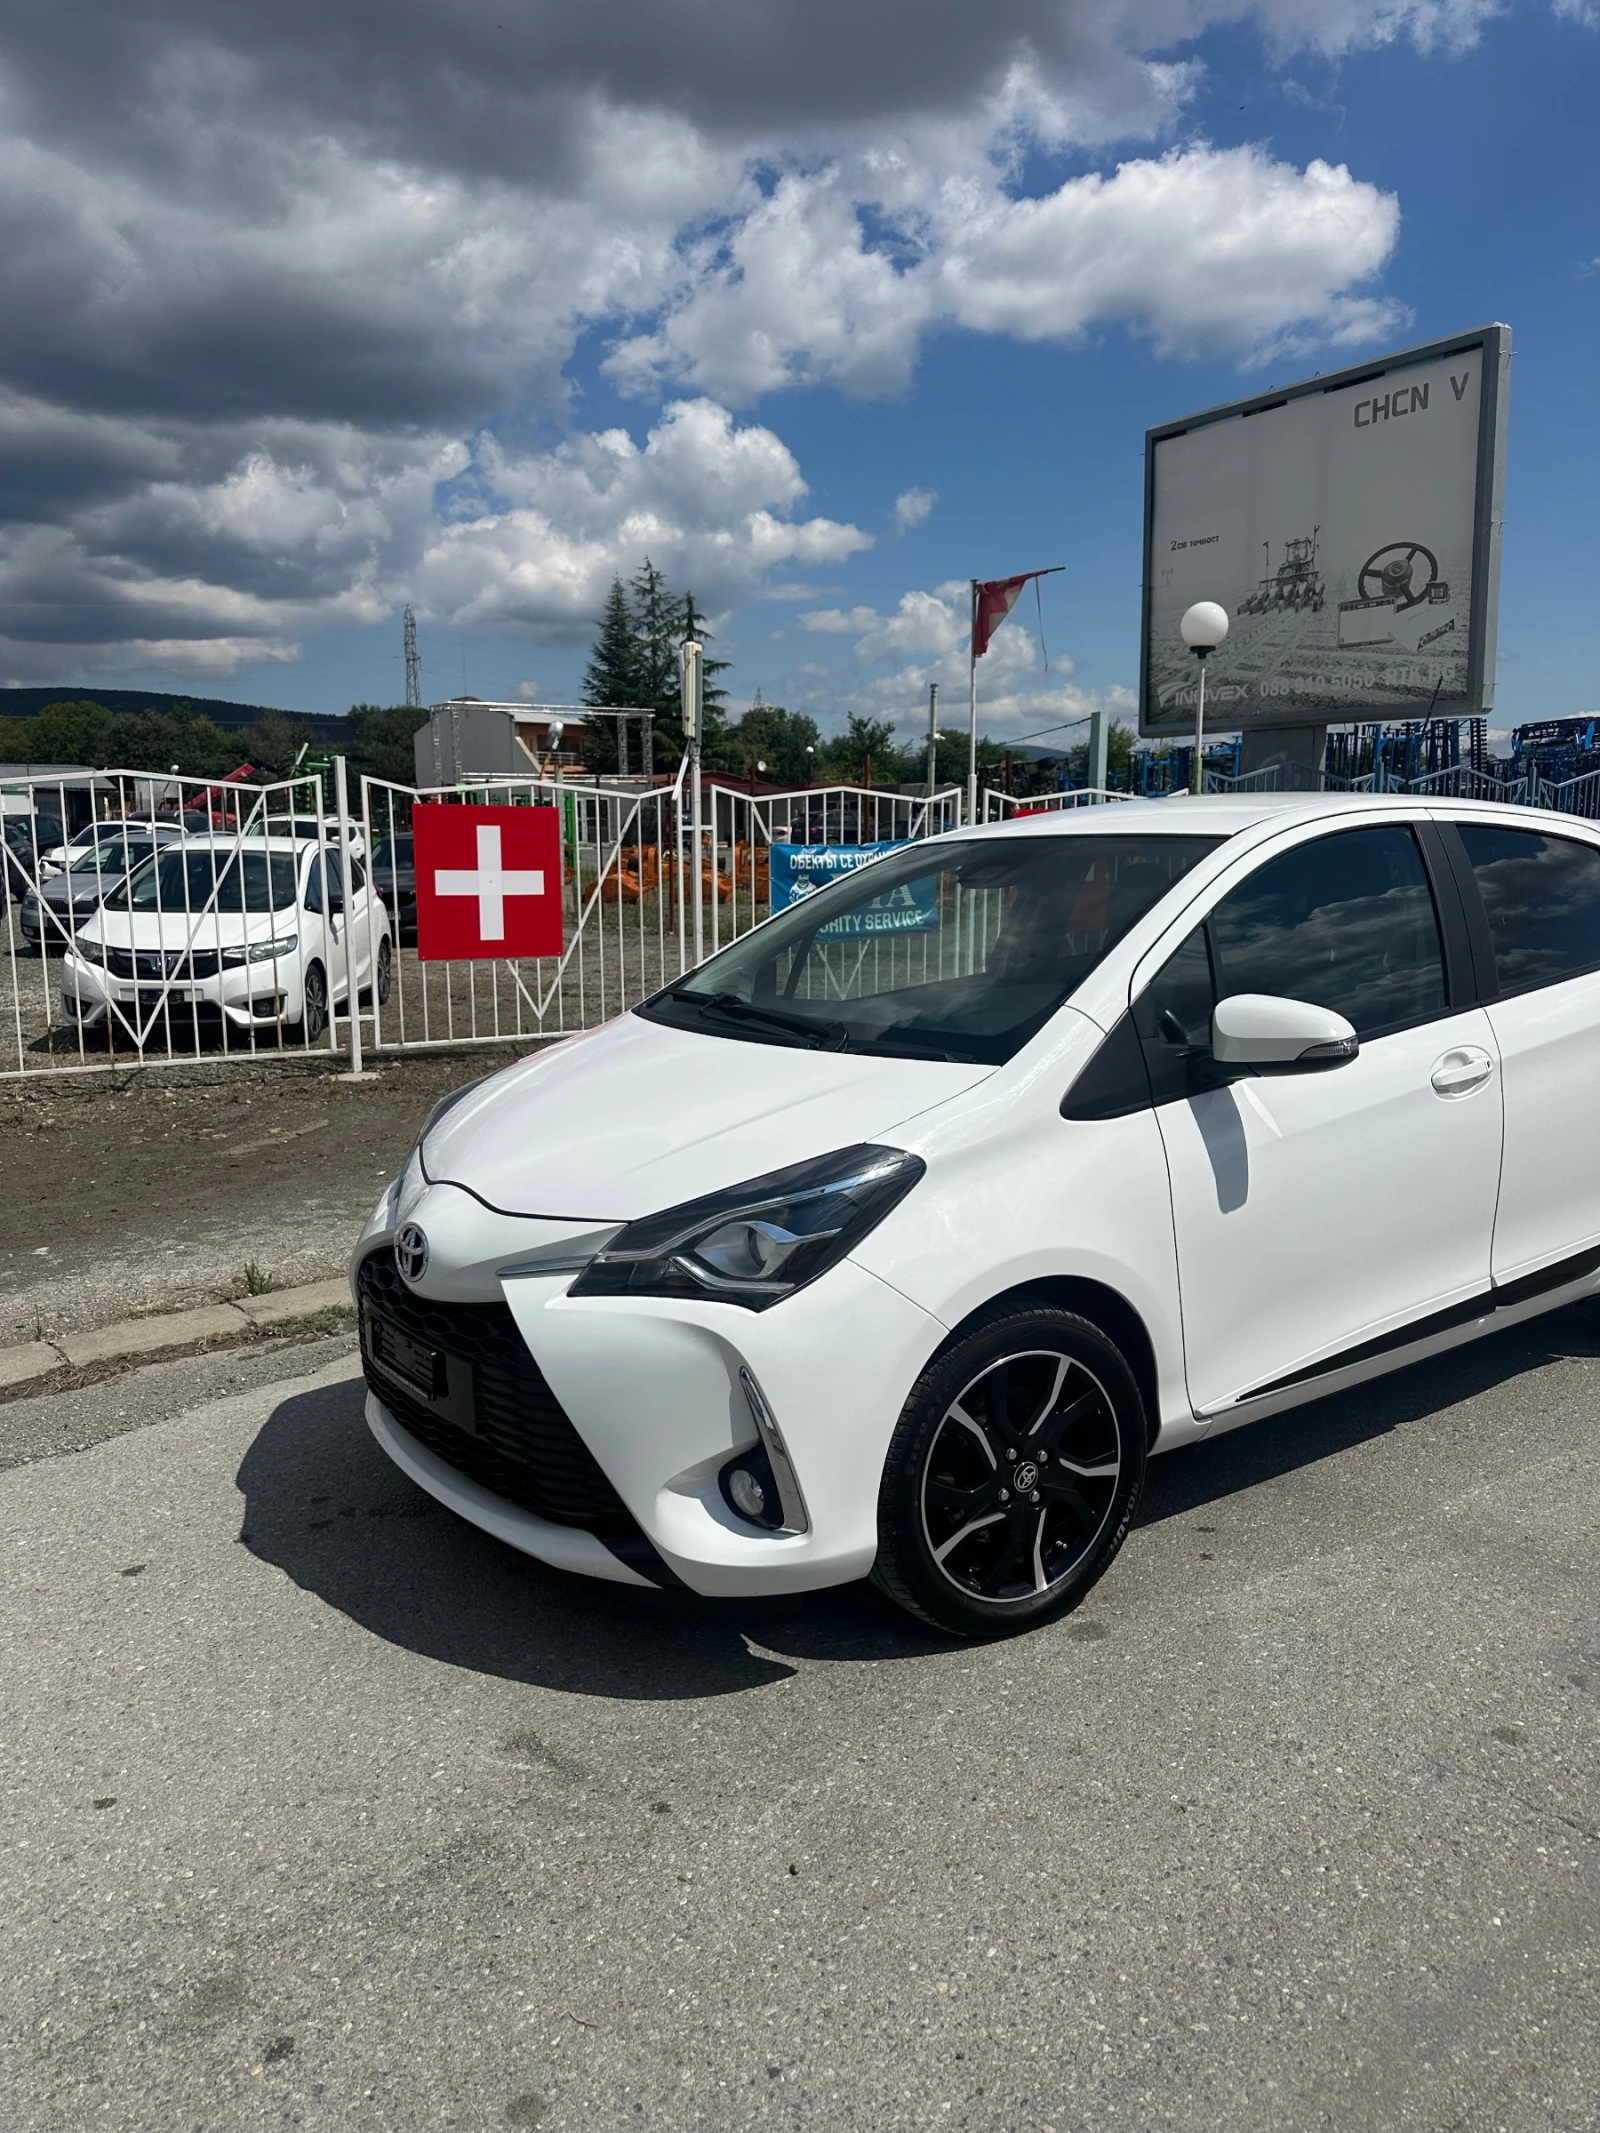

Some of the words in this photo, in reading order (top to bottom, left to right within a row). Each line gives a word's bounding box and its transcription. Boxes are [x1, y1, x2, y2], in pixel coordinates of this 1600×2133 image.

[1175, 683, 1249, 706] INOVEX
[1260, 679, 1290, 698] 088
[1331, 670, 1375, 691] 5050
[840, 853, 854, 868] СЕ
[865, 909, 924, 931] SERVICE
